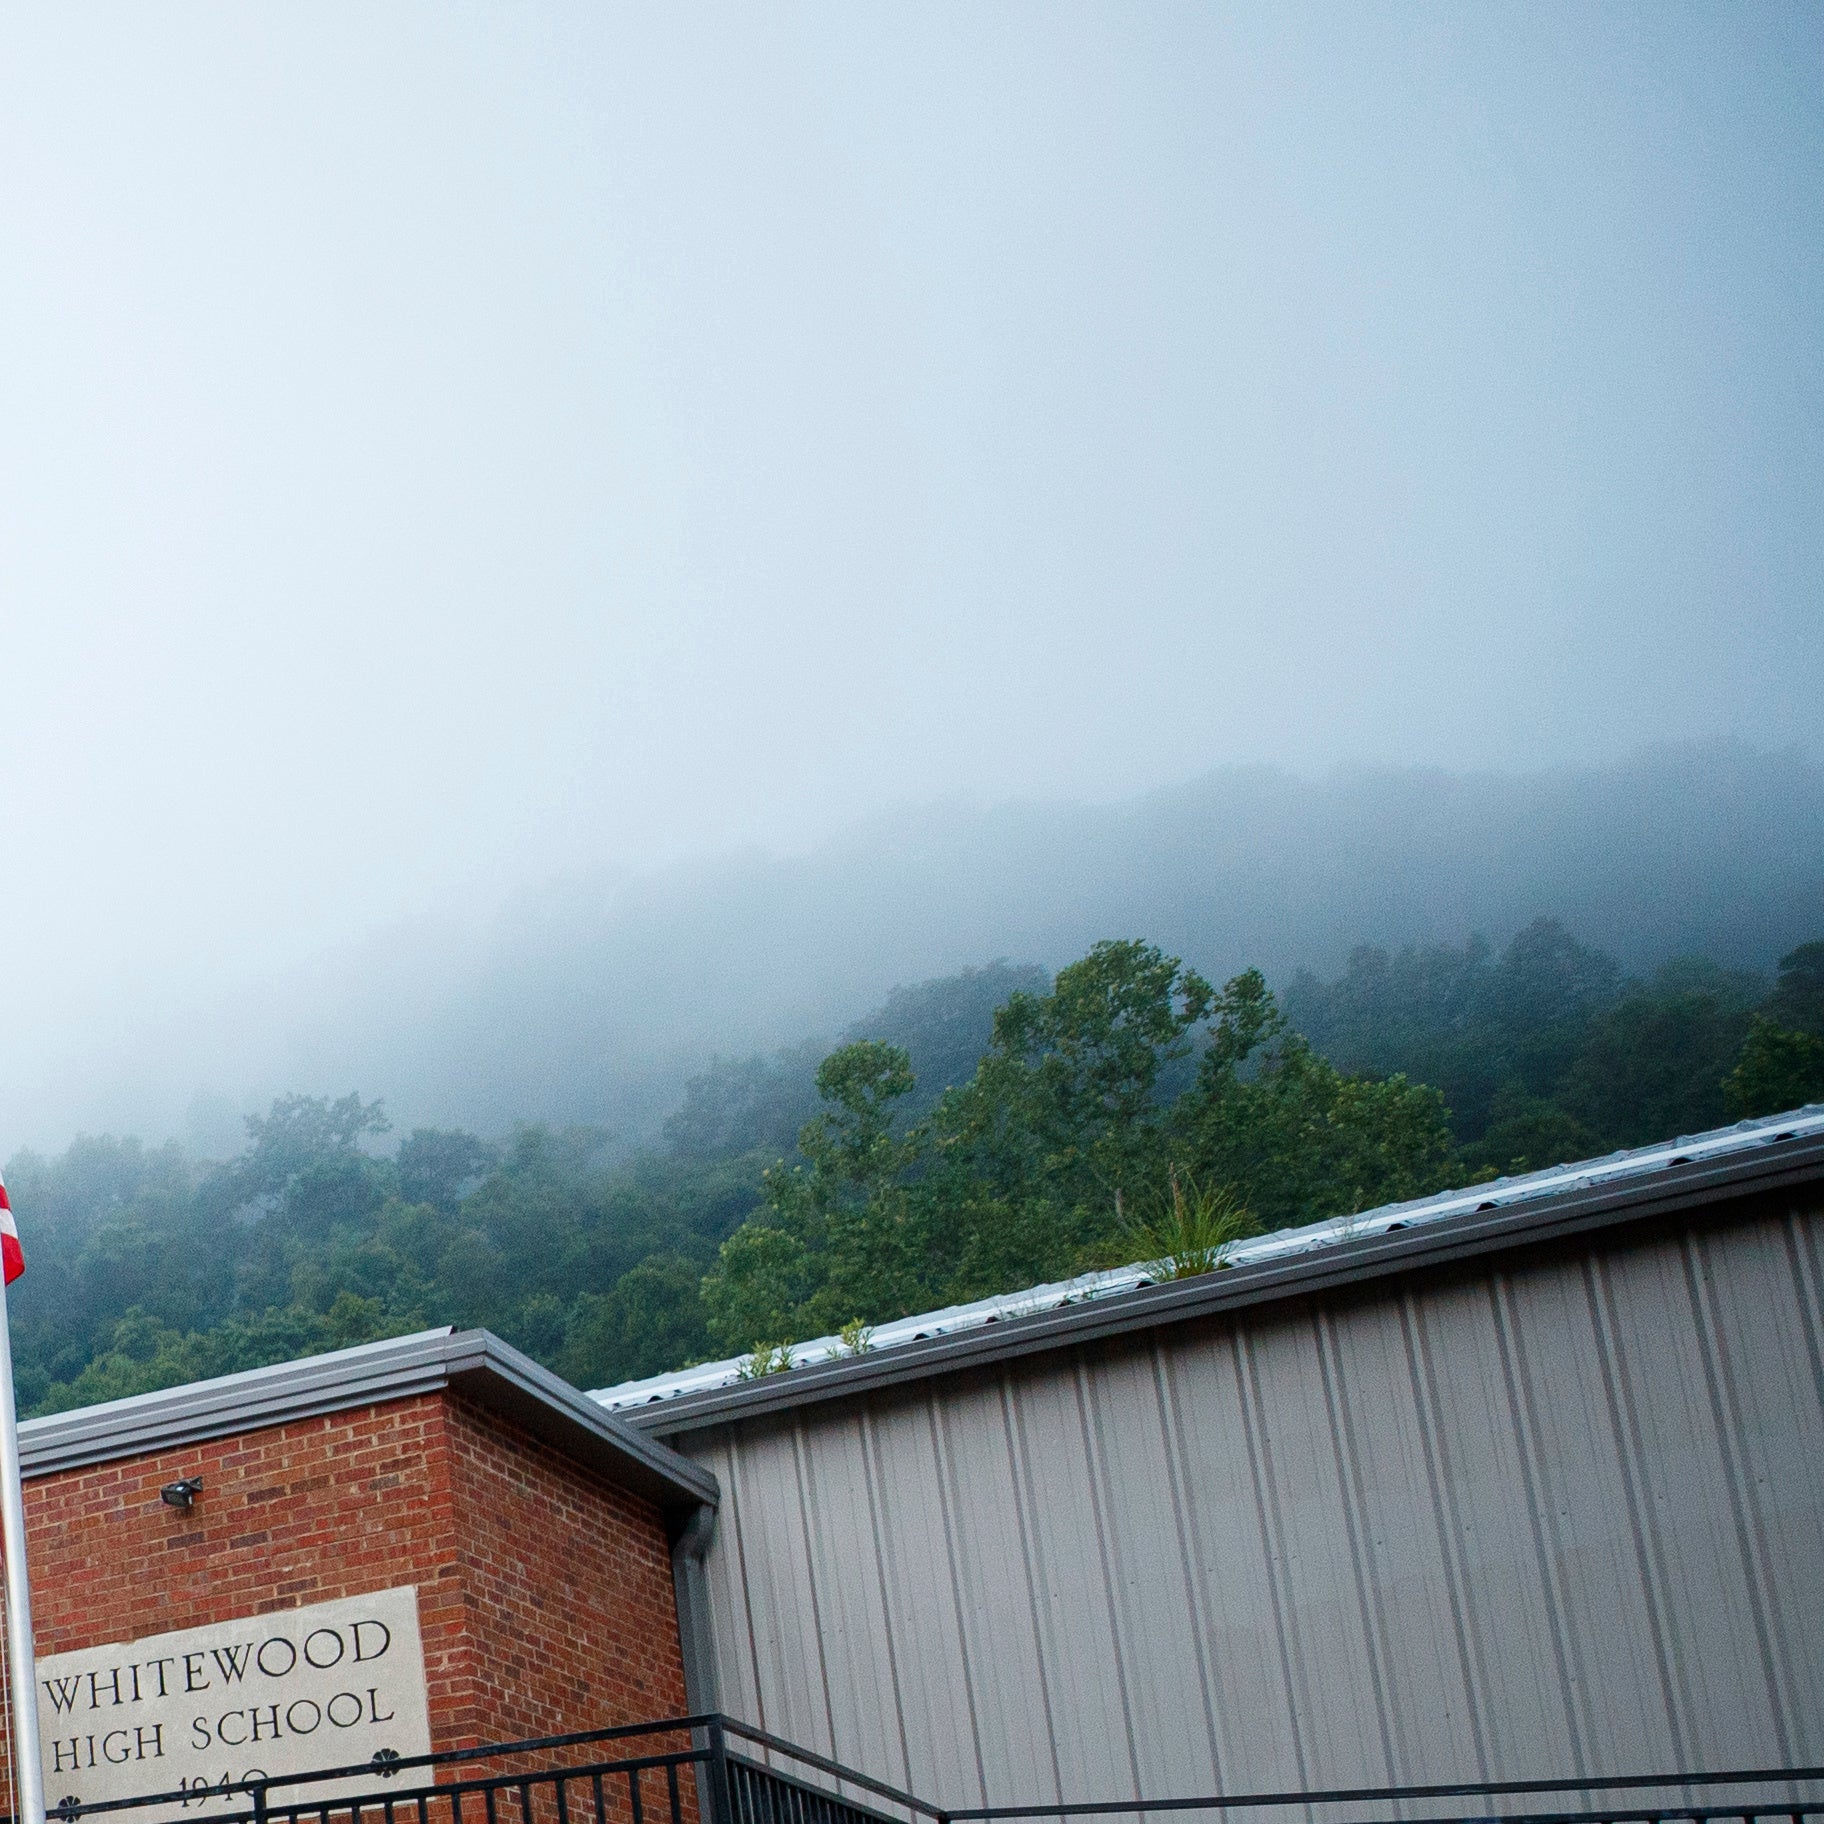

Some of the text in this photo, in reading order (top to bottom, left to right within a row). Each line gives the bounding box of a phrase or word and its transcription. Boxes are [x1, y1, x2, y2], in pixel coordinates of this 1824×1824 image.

[42, 1620, 391, 1715] WHITEWOOD
[53, 1688, 395, 1773] HIGH SCHOOL
